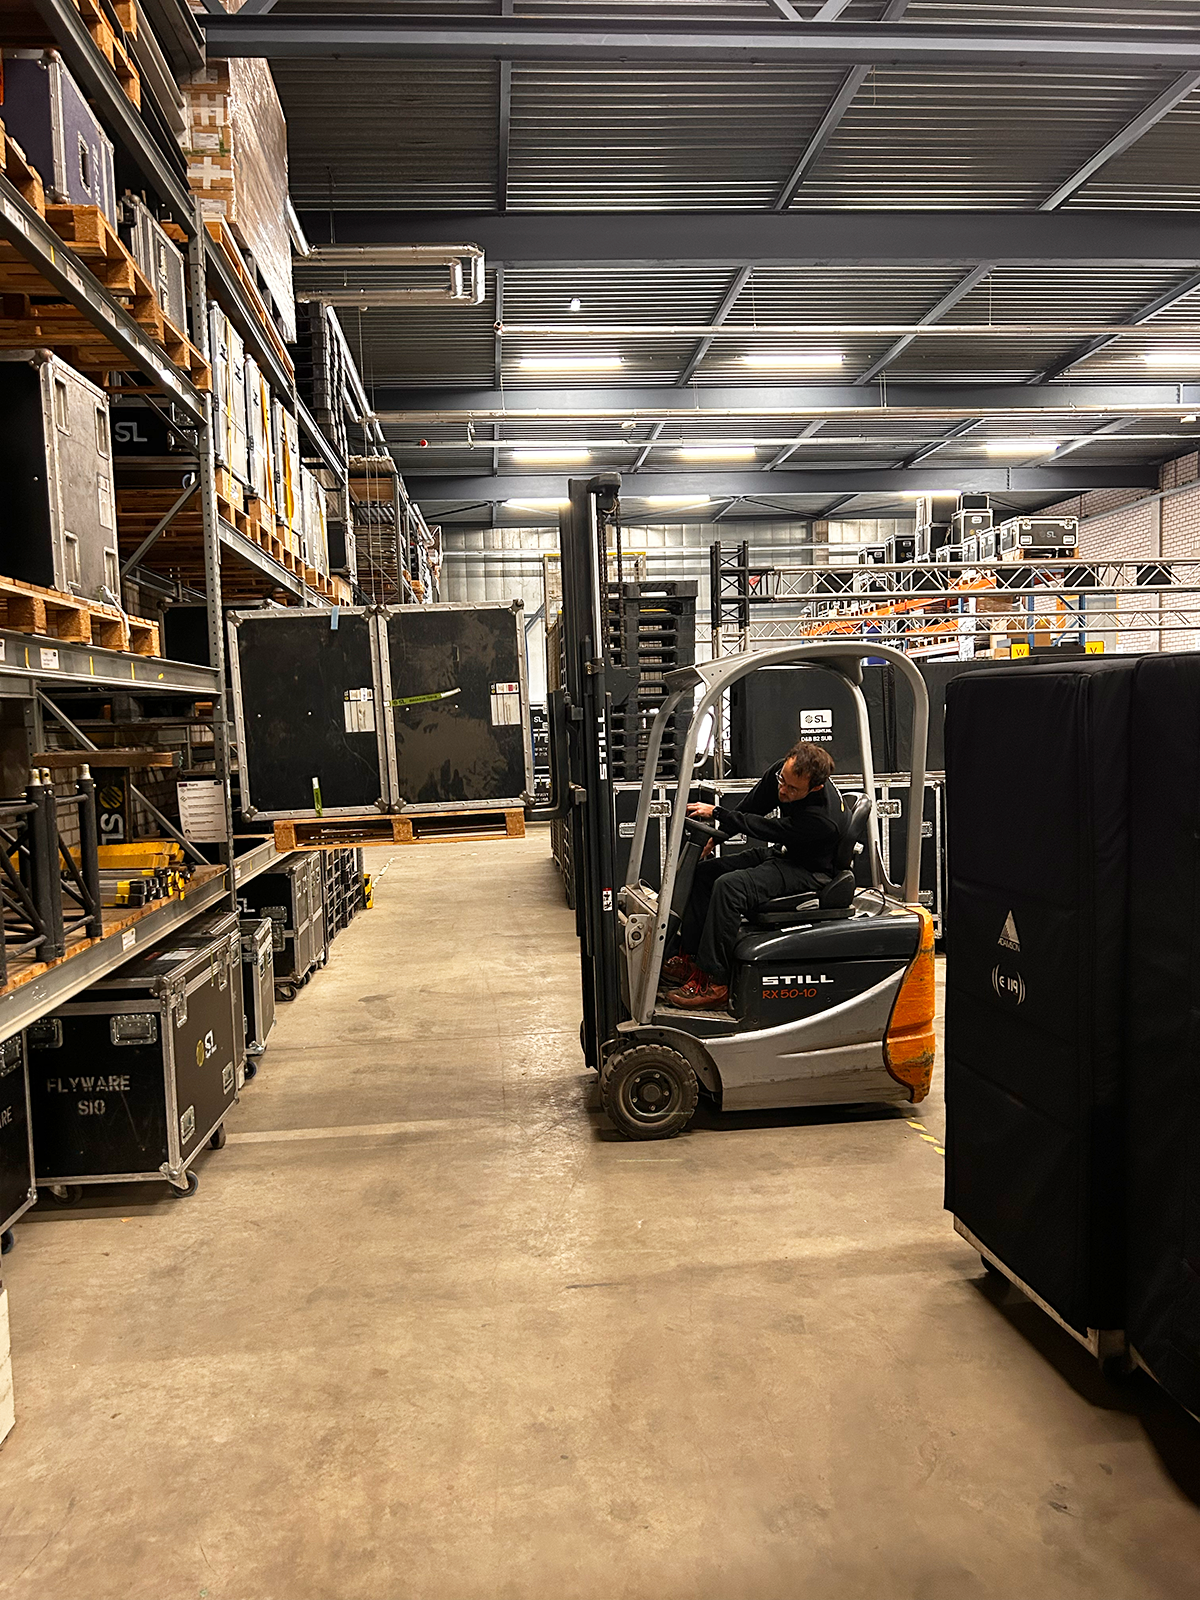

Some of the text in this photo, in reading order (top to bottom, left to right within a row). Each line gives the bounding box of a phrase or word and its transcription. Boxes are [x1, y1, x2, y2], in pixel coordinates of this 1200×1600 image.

[115, 422, 148, 442] SL
[1046, 531, 1057, 539] SL
[1016, 648, 1026, 656] W
[533, 715, 544, 724] SL
[814, 715, 827, 723] SL
[598, 708, 608, 780] STILL
[762, 974, 835, 986] STILL
[46, 1075, 131, 1093] FLYWARE
